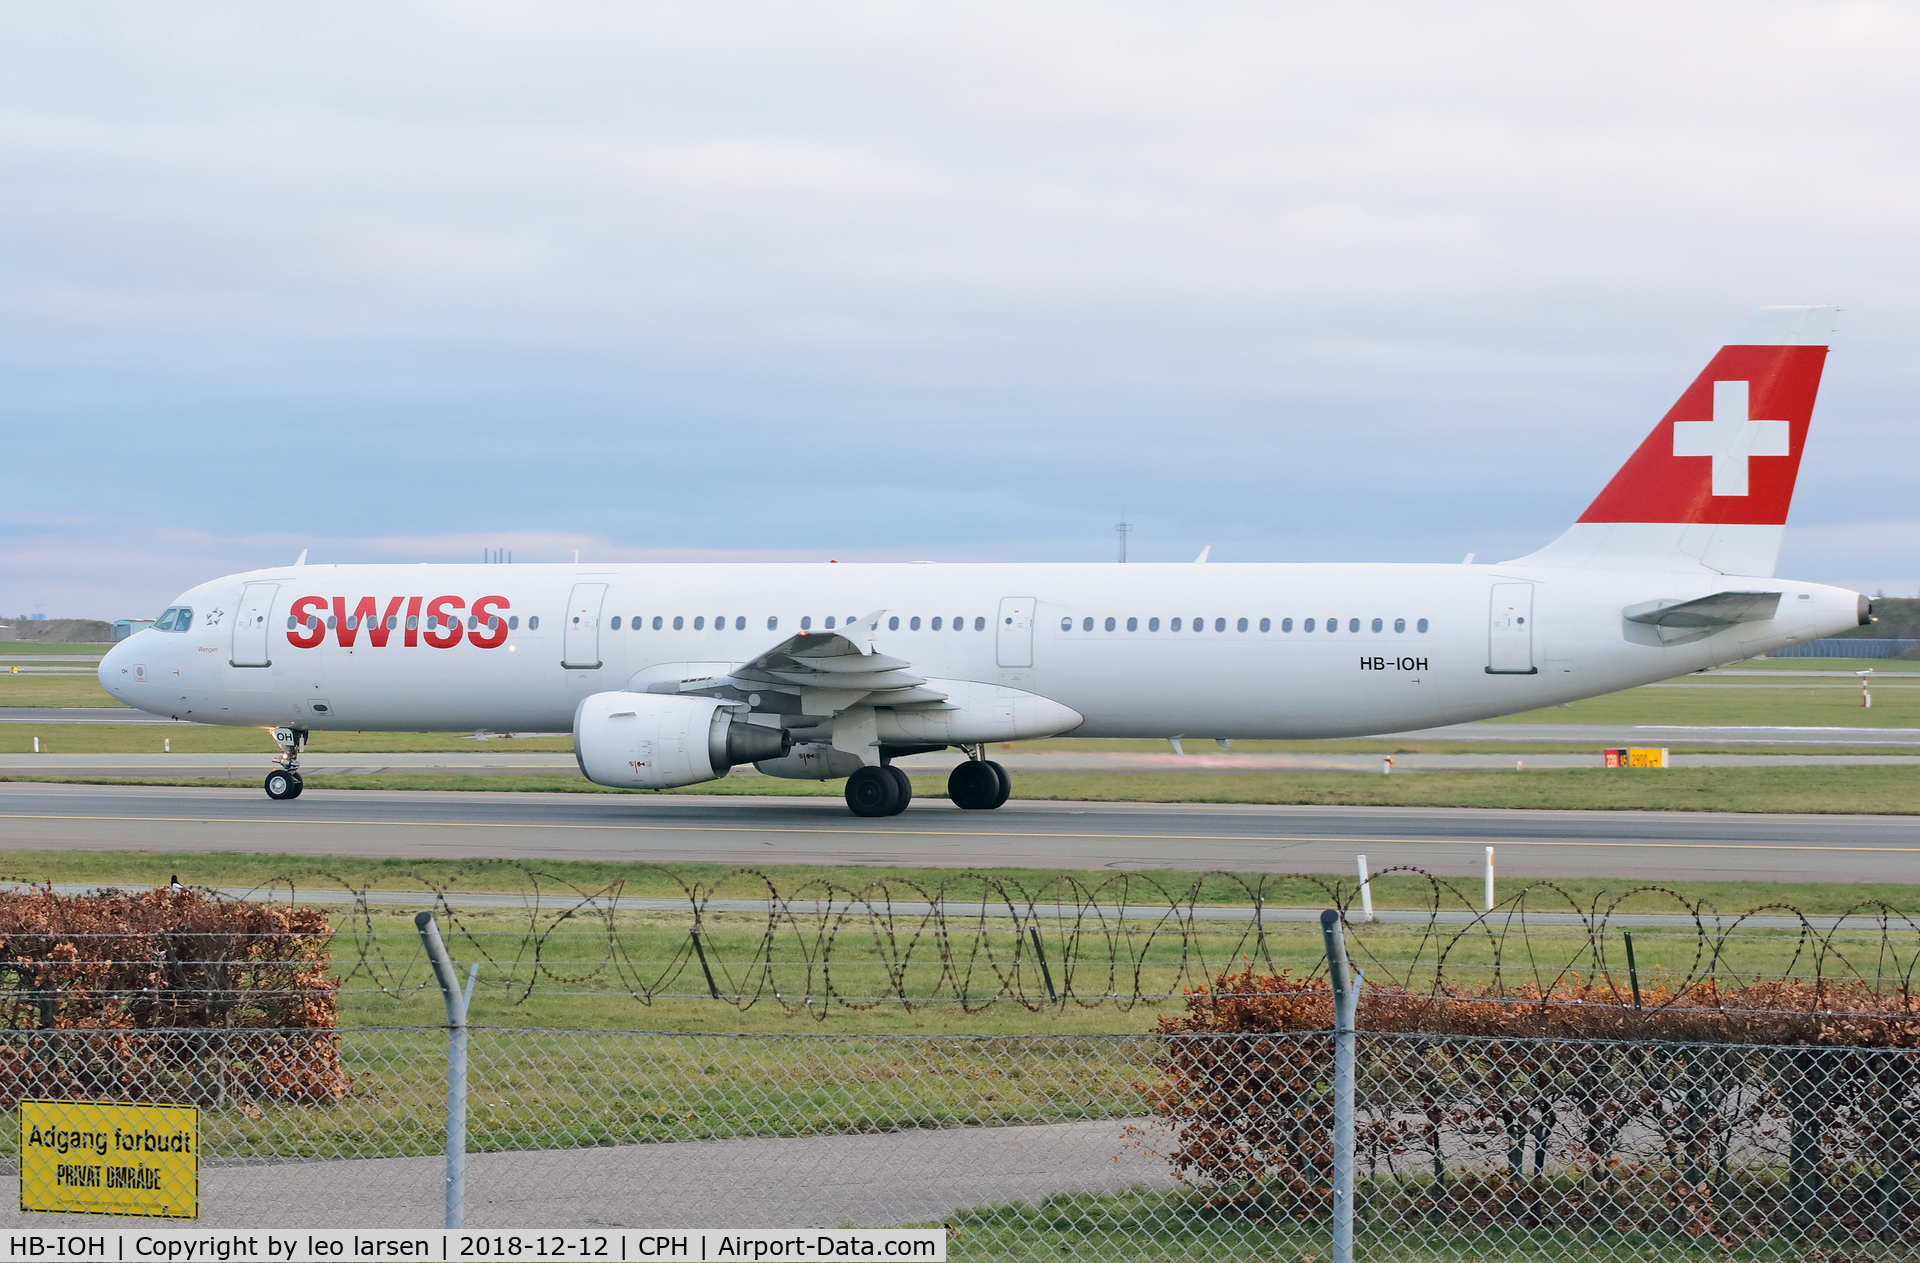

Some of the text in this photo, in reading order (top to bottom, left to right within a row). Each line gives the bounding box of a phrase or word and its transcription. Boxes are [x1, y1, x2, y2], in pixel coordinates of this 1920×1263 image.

[286, 595, 511, 649] SWISS
[1360, 657, 1428, 670] HB-IOH
[277, 733, 292, 741] OH
[29, 1125, 191, 1155] Adgang forbudt
[57, 1162, 161, 1190] PRIVAT OMRÅDE
